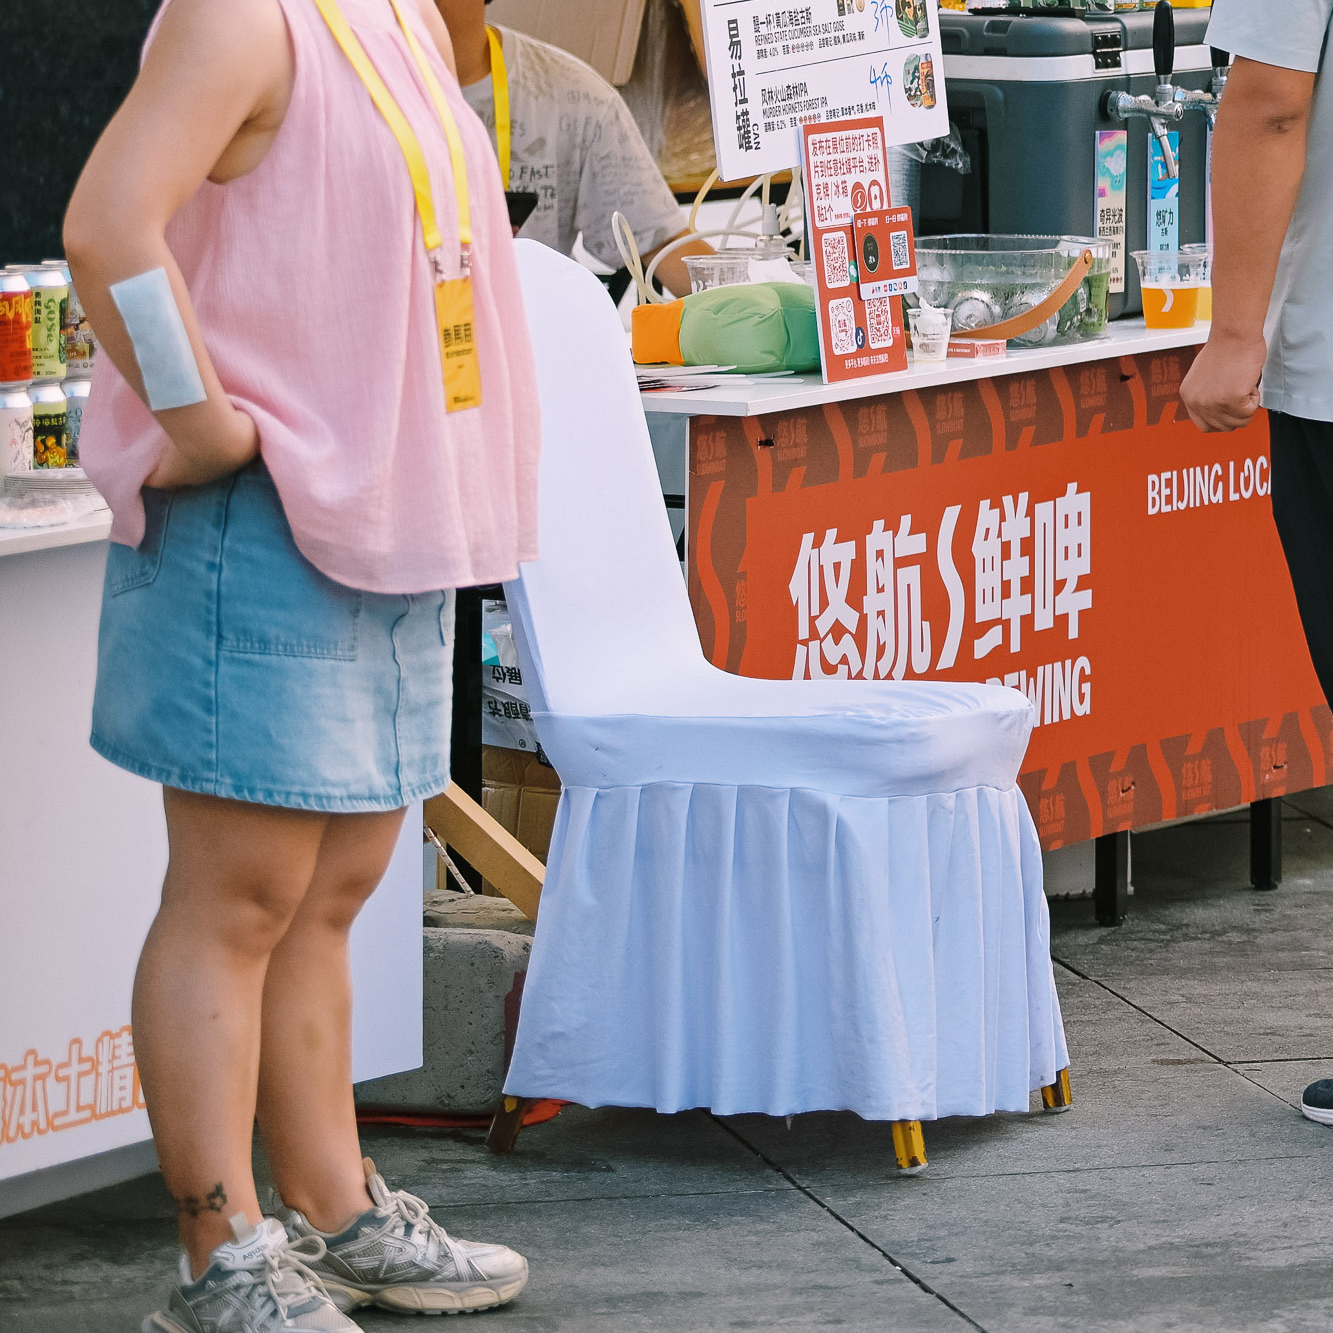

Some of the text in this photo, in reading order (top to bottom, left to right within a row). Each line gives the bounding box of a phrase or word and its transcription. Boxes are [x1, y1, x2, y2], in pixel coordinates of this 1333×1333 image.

[752, 122, 762, 151] CAN
[1147, 463, 1223, 516] BEIJING
[0, 1025, 150, 1145] 本土精
